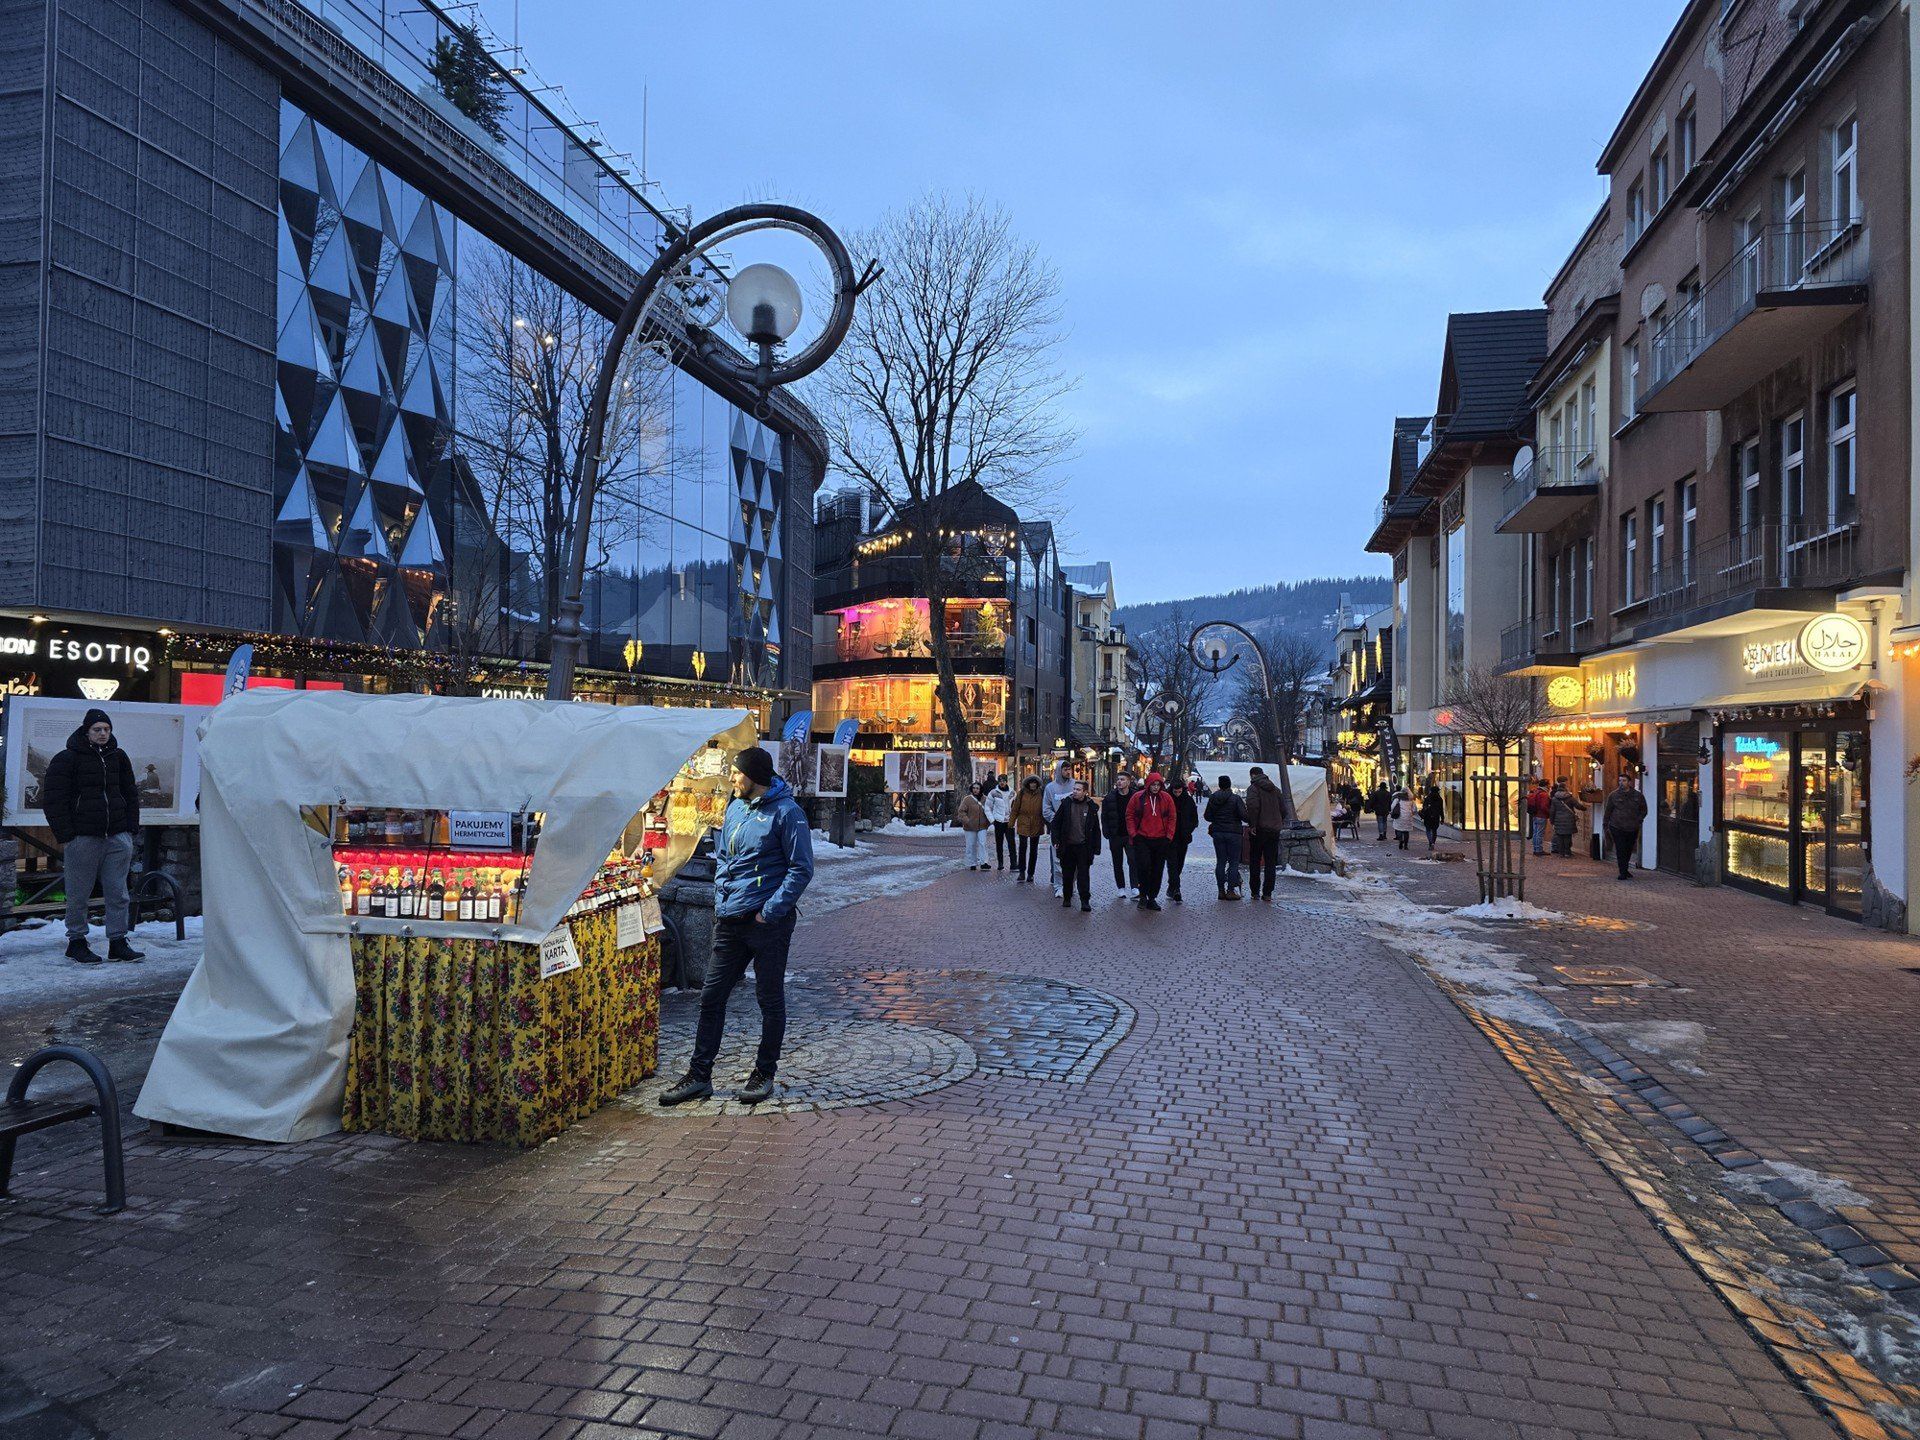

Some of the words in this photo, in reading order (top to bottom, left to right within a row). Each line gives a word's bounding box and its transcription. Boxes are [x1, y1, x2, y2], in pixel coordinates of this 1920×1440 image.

[49, 639, 150, 672] ESOTIQ
[894, 735, 943, 749] Księstwo
[455, 820, 504, 829] PAKUJEMY
[454, 830, 506, 838] HERMETYCZNIE
